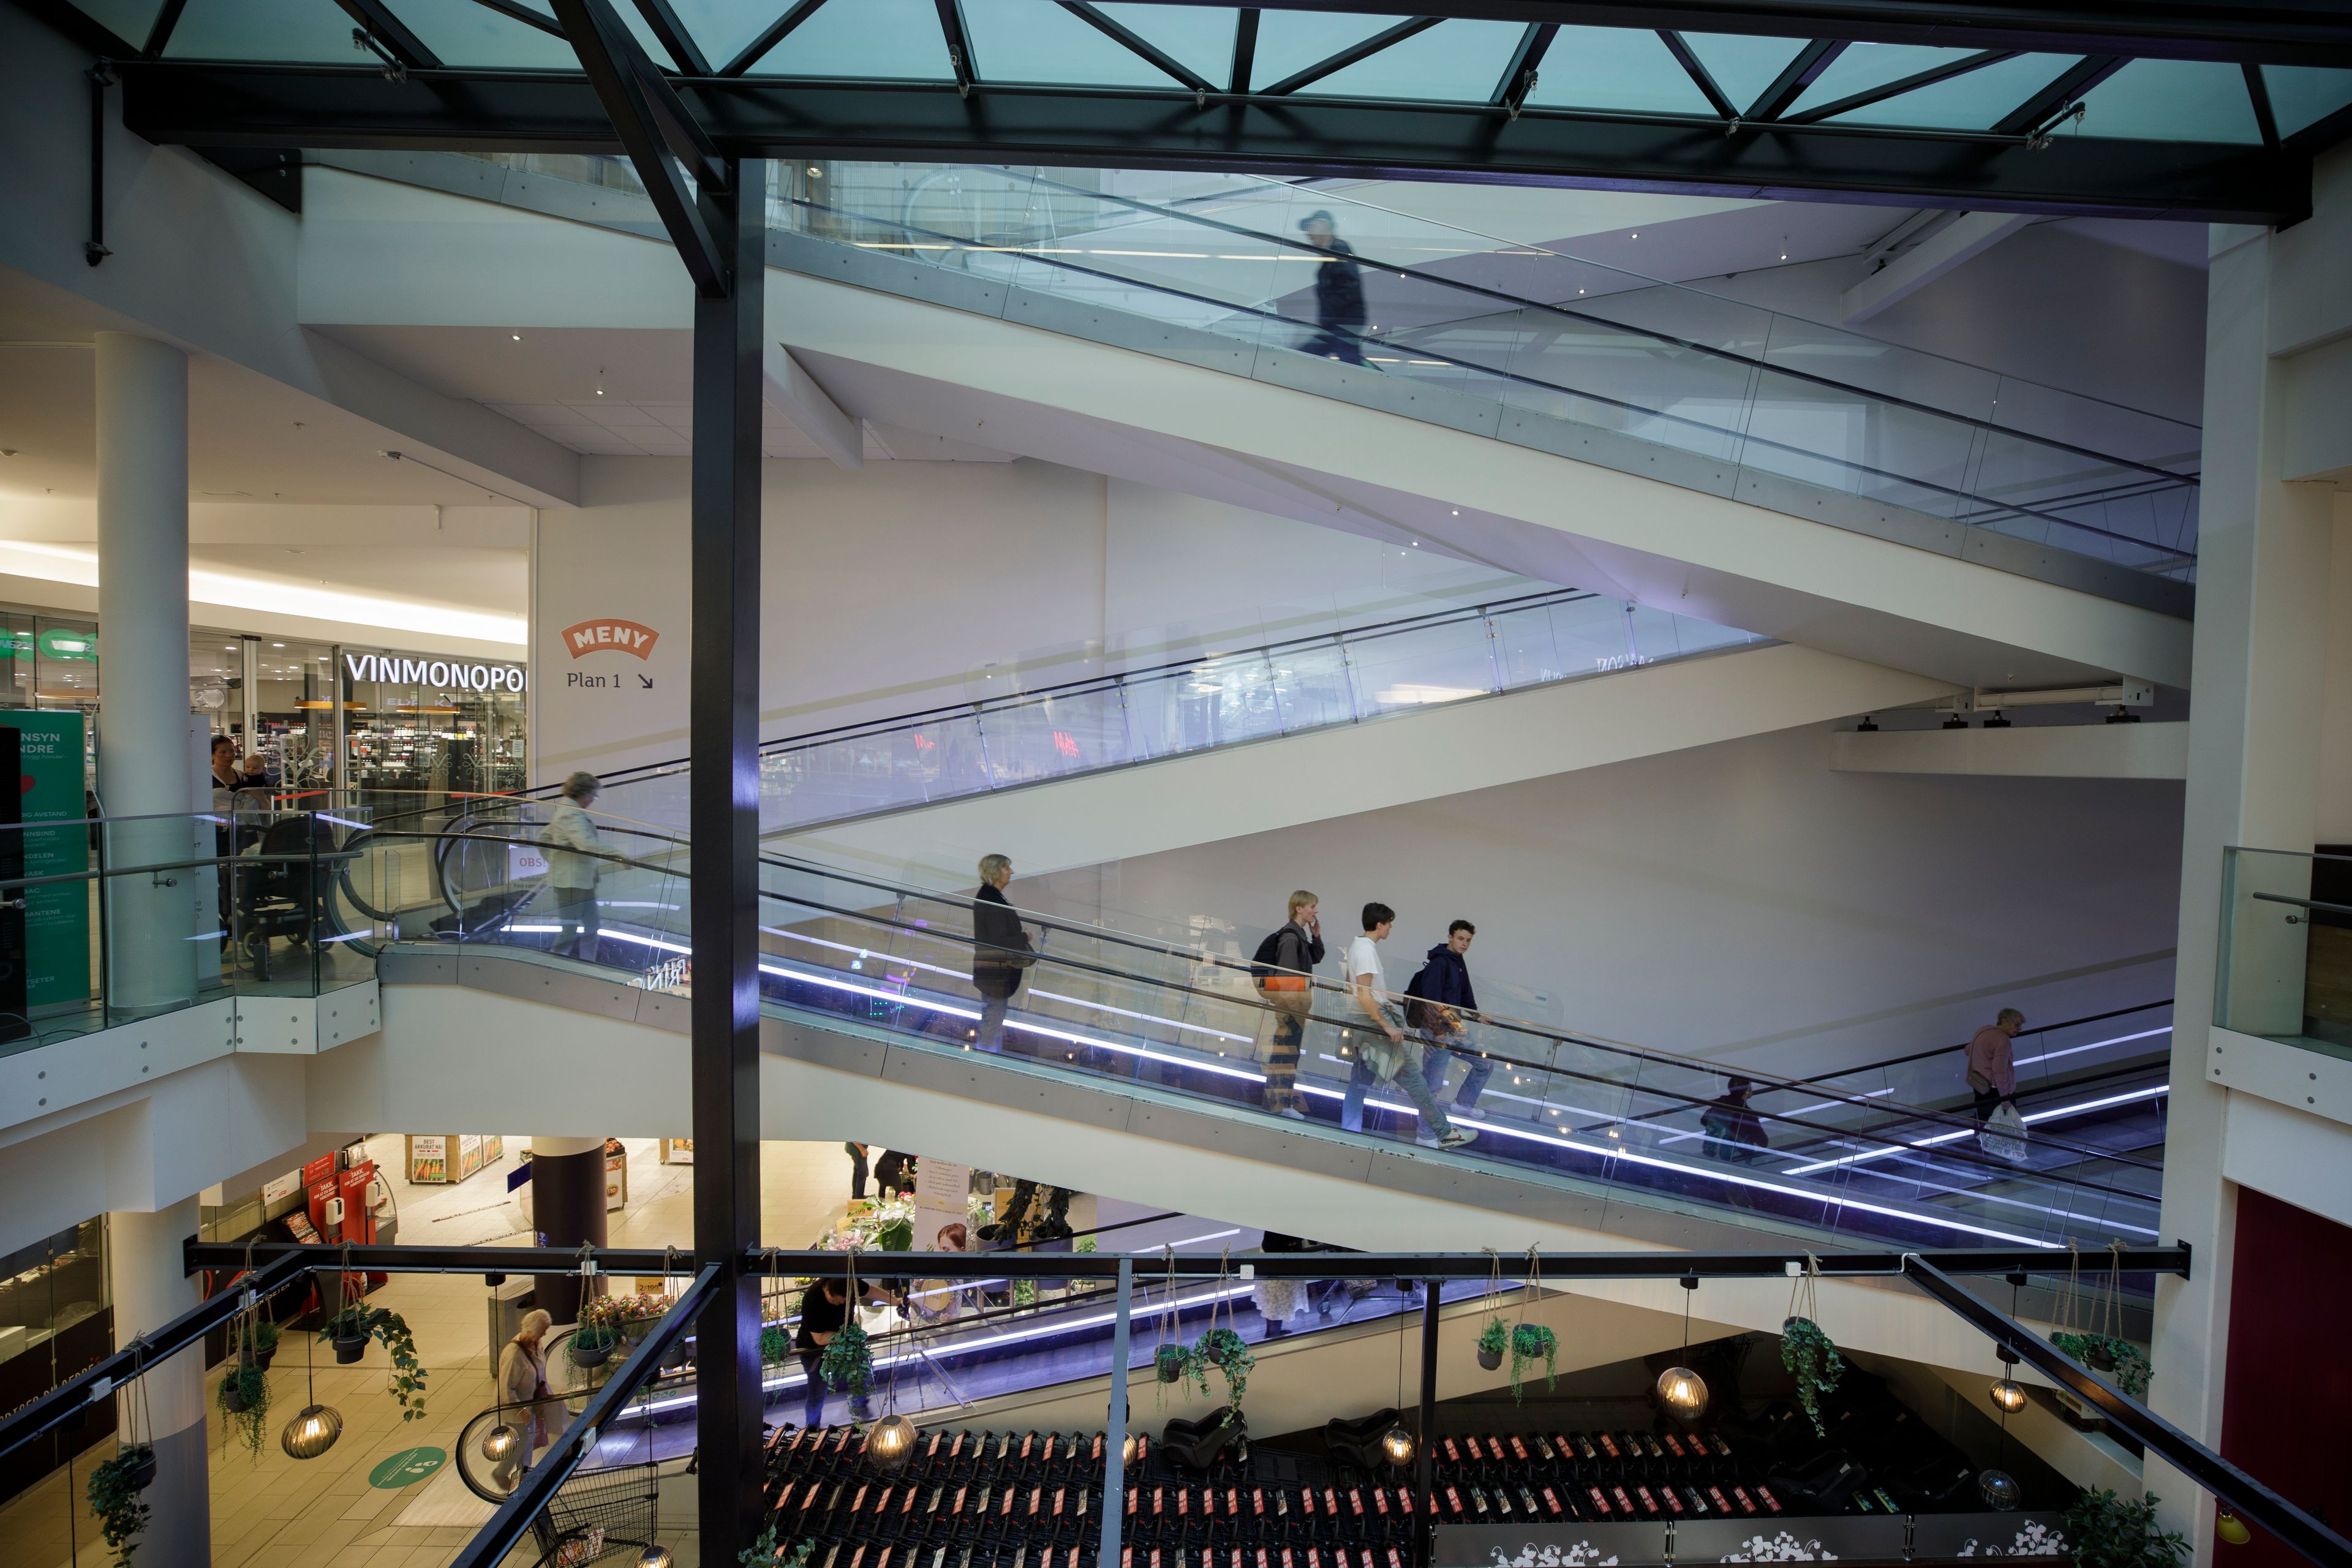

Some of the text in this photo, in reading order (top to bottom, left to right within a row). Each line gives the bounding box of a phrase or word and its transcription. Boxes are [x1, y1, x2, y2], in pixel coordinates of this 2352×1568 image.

[573, 626, 649, 649] MENY
[345, 654, 527, 693] VINMONOPO
[567, 672, 620, 688] Plan 1
[519, 858, 546, 867] OBS!
